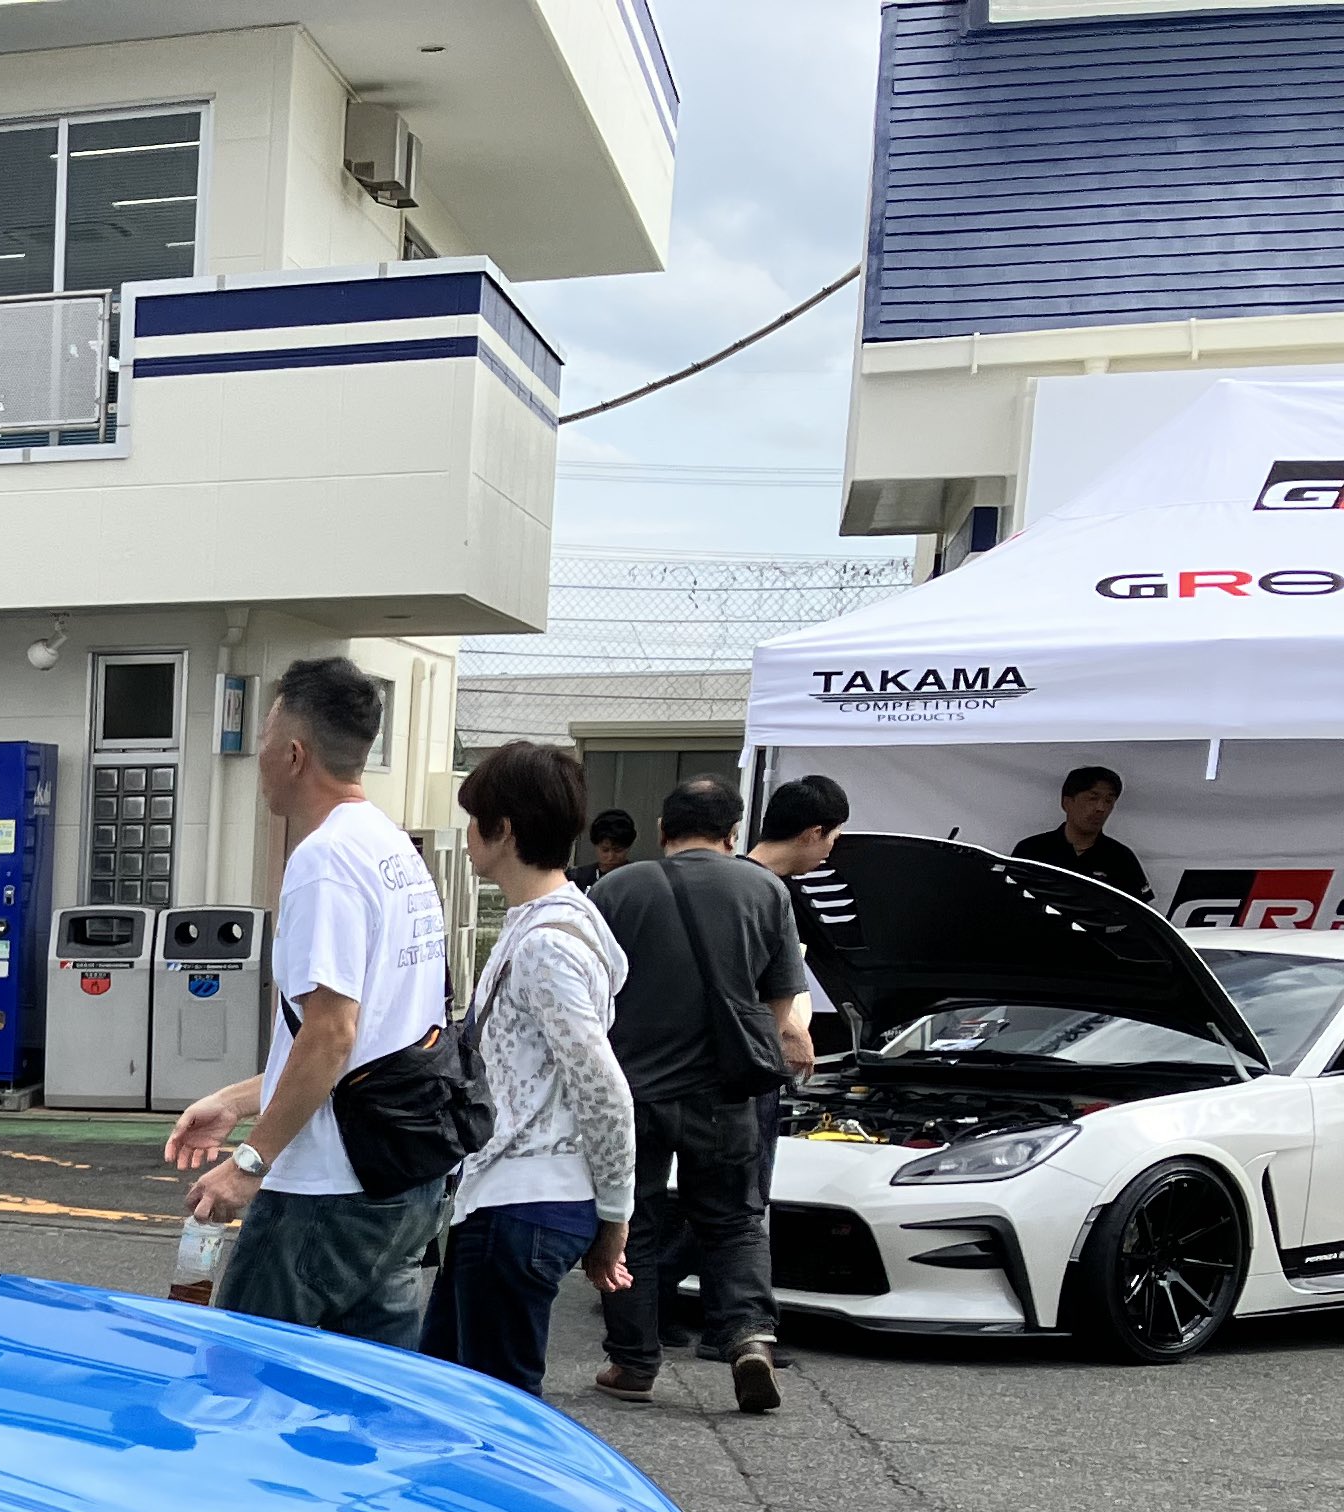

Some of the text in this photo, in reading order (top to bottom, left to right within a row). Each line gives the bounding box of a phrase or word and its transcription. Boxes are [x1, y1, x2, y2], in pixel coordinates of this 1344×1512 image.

[812, 666, 1027, 693] TAKAMA
[839, 698, 997, 714] COMPETITION
[877, 712, 965, 722] PRODUCTS
